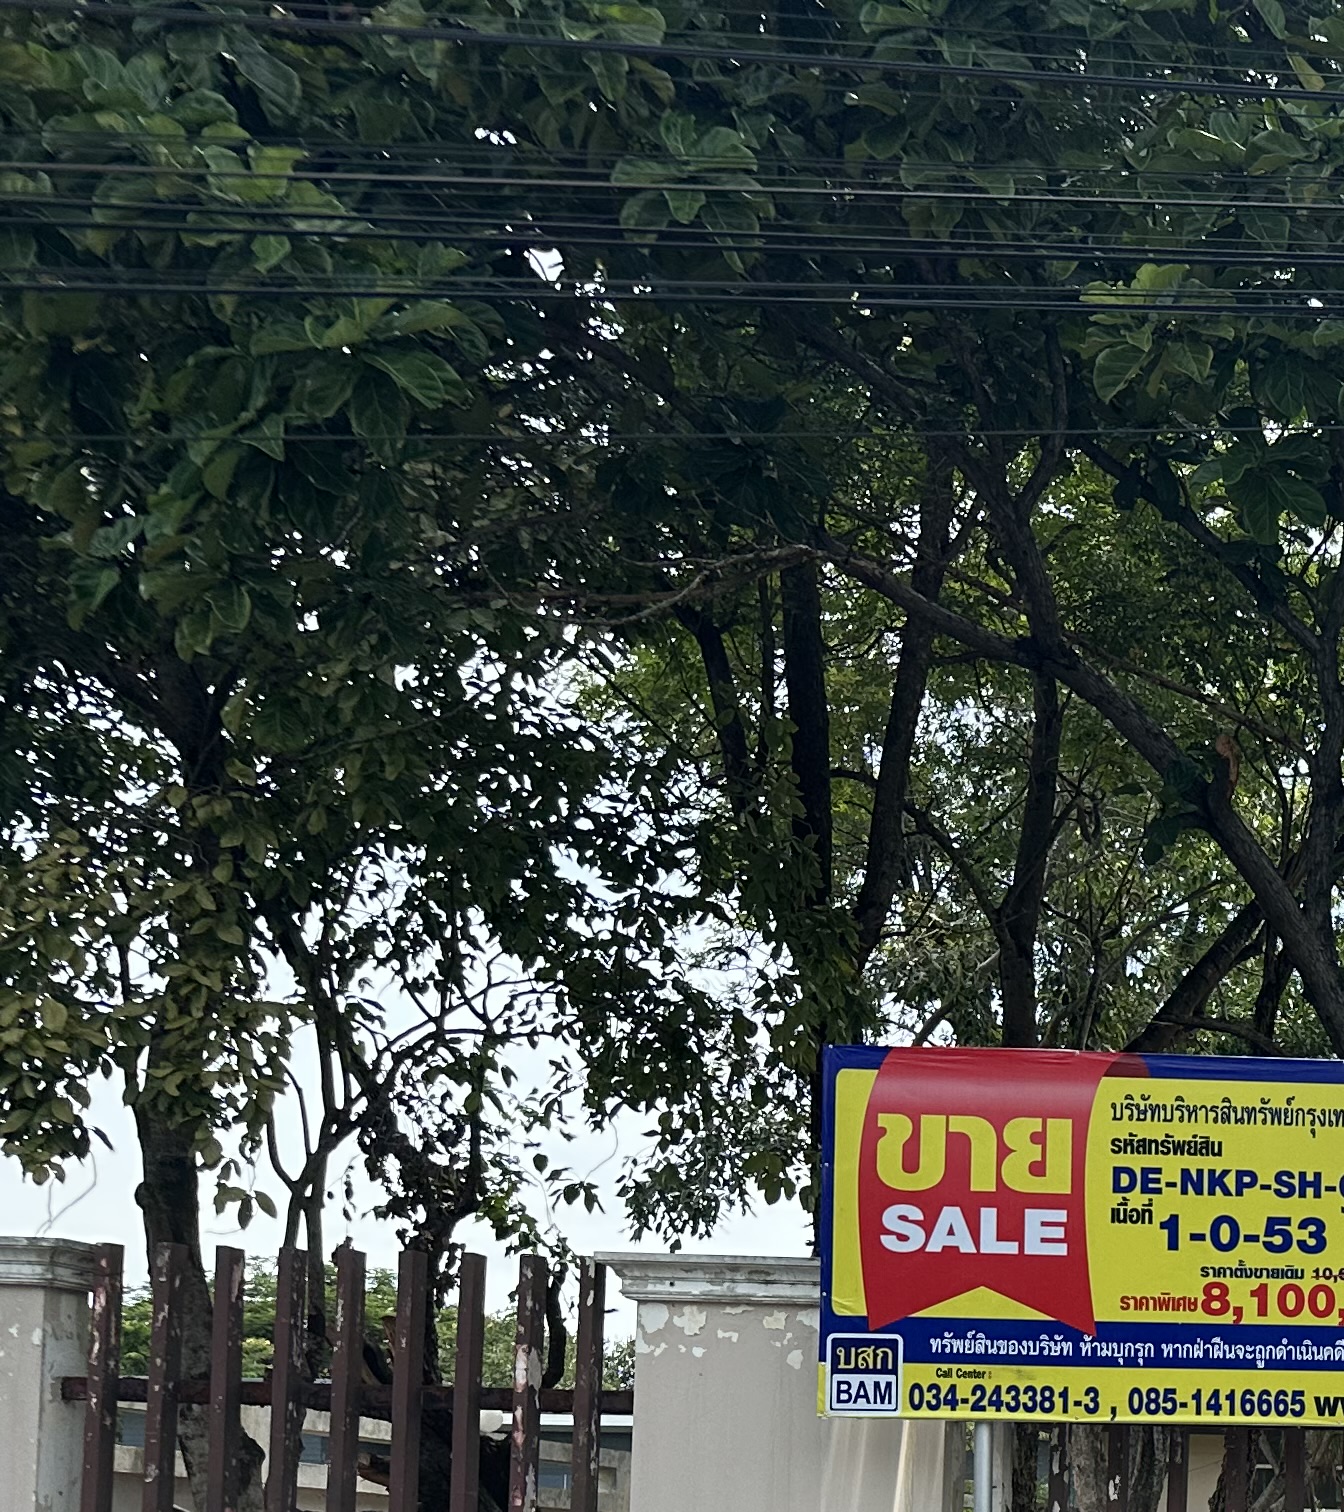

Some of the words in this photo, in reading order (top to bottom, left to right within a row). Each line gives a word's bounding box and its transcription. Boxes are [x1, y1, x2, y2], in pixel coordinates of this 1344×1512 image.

[876, 1113, 1073, 1194] ขาย
[1111, 1132, 1223, 1157] รหัสทรัพย์สิน
[880, 1204, 1068, 1256] SALE
[1111, 1197, 1154, 1225] เนื้อที่
[1159, 1213, 1327, 1255] 1-0-53
[1200, 1259, 1305, 1280] ราคาตั้งขายเดิม
[1120, 1288, 1198, 1314] ราคาพิเศษ
[836, 1346, 893, 1370] บสก
[930, 1331, 1073, 1357] ทรัพย์สินของบริษัท
[1080, 1334, 1155, 1365] ห้ามบุกรุก
[936, 1367, 953, 1379] Call
[956, 1368, 987, 1380] Center
[836, 1380, 893, 1405] BAM
[909, 1383, 1100, 1415] 034-243381-3
[1128, 1387, 1306, 1418] 085-1416665
